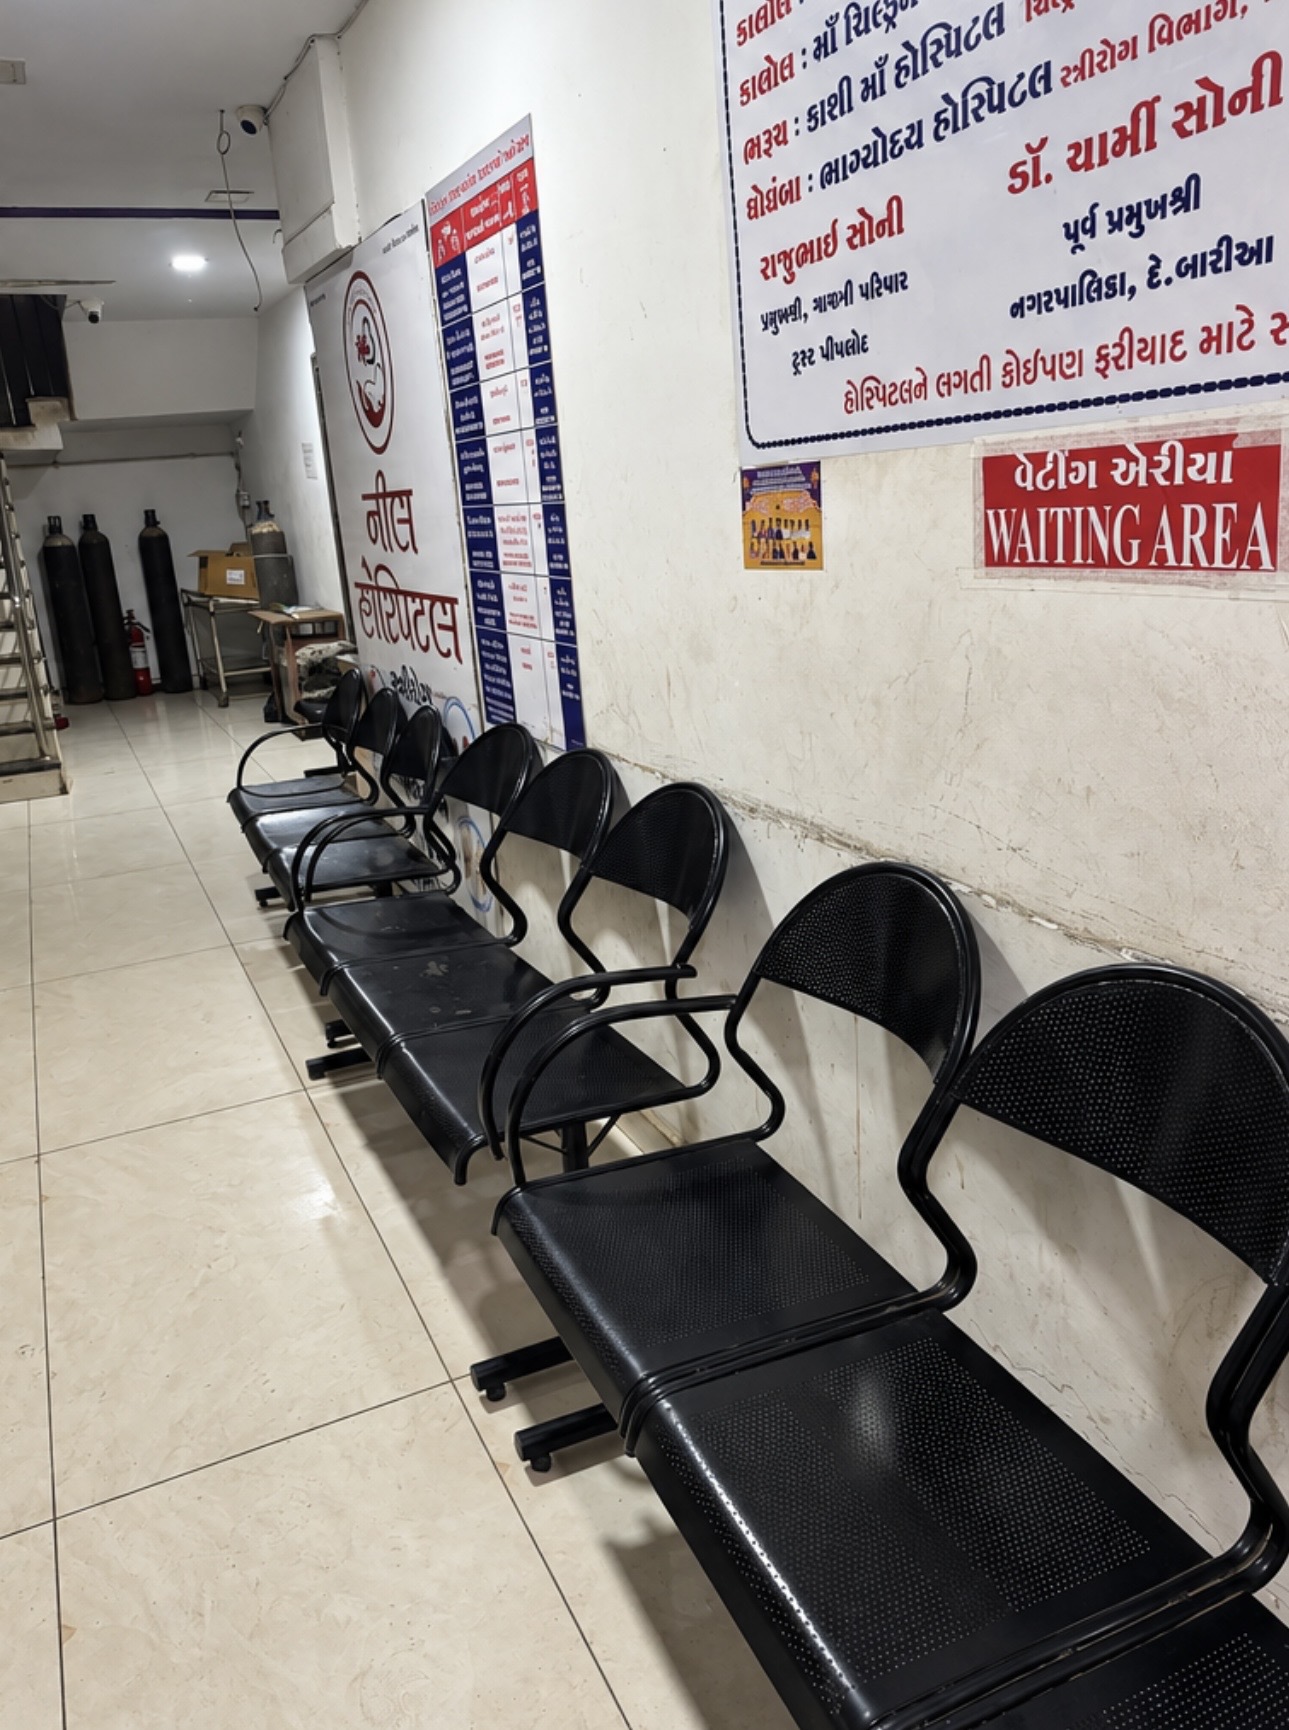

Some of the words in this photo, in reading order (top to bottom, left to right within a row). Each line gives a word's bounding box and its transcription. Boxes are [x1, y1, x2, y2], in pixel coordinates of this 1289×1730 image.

[739, 52, 796, 107] કાલોલ
[743, 120, 789, 164] ભરૂચ
[806, 75, 854, 133] કાશી
[894, 3, 1006, 89] હોસ્પિટલ
[819, 119, 924, 190] ભાગ્યોદય
[932, 60, 1053, 143] હોસ્પિટલ
[1060, 35, 1138, 88] સ્ત્રીરોગ
[1066, 95, 1162, 173] ચાર્મી
[1171, 50, 1284, 140] સોની
[760, 218, 839, 285] રાજુભાઈ
[846, 195, 905, 250] સોની
[1062, 203, 1099, 255] પૂર્વ
[1105, 173, 1201, 239] પ્રમુખશ્રી
[1010, 269, 1137, 319] નગરપાલિકા,
[844, 366, 928, 415] હોસ્પિટલને
[936, 354, 992, 399] લગતી
[1001, 348, 1084, 389] કોઈપણ
[1095, 326, 1188, 379] ફરીયાદ
[1199, 304, 1256, 355] માટે
[1110, 440, 1233, 487] એરીયા
[986, 503, 1142, 566] WAITING
[1149, 501, 1275, 571] AREA
